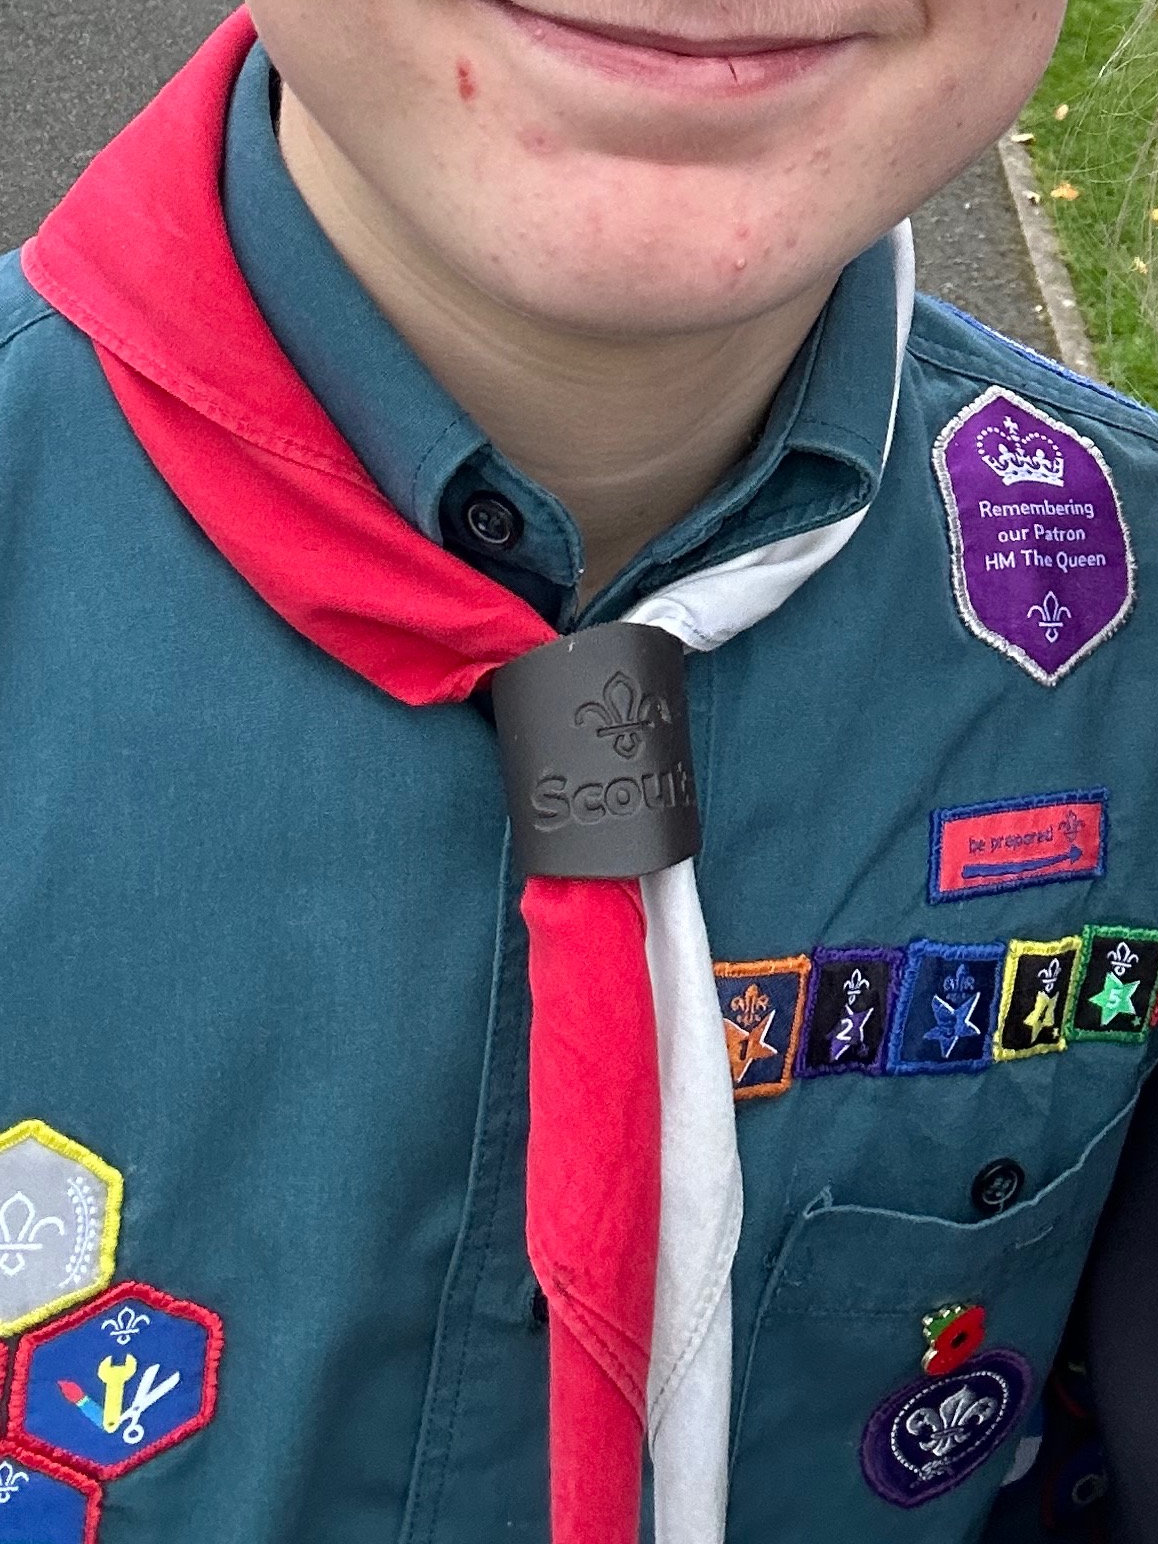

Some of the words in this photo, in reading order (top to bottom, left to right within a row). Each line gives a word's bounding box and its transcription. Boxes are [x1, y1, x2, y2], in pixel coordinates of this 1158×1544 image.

[978, 498, 1095, 519] Remembering
[997, 527, 1030, 543] our
[1033, 523, 1086, 542] Patron
[985, 551, 1016, 572] HM
[1020, 548, 1053, 568] The
[1056, 551, 1107, 573] Queen
[968, 837, 986, 853] be
[990, 827, 1054, 853] prepared
[1107, 987, 1123, 1009] 5
[836, 1018, 854, 1041] 2
[739, 1038, 749, 1061] 1
